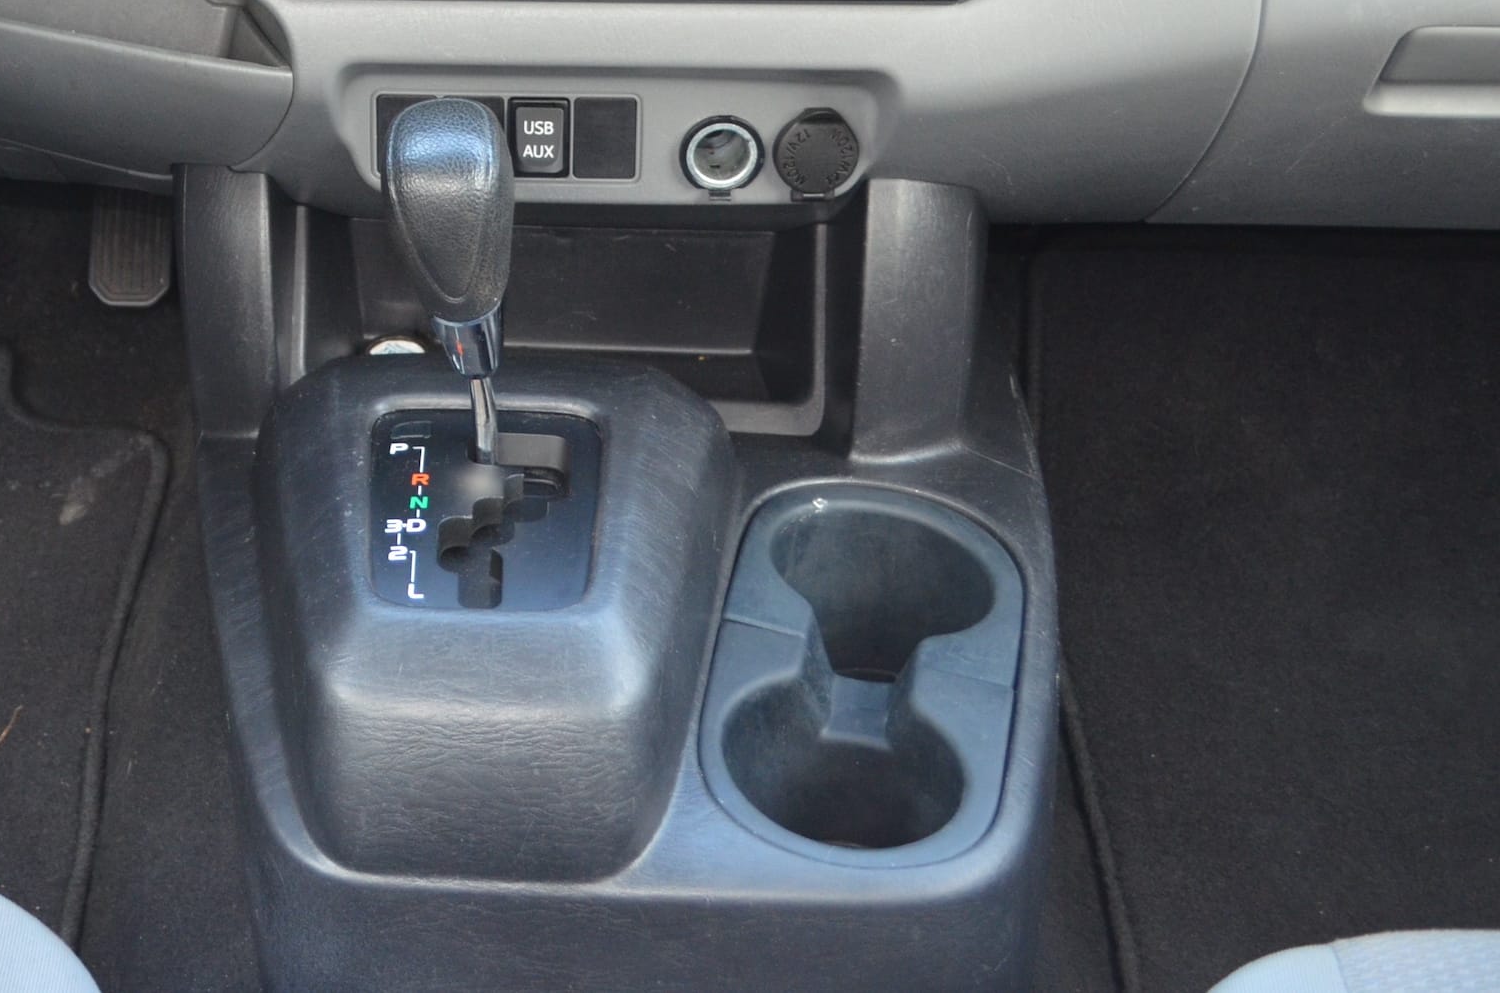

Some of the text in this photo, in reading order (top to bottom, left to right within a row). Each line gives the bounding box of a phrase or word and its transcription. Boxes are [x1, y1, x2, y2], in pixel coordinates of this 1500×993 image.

[523, 120, 554, 135] USB
[522, 144, 555, 158] AUX
[389, 443, 410, 455] P
[411, 473, 431, 486] R
[409, 496, 430, 509] N
[388, 545, 409, 561] 2
[407, 583, 425, 599] L
